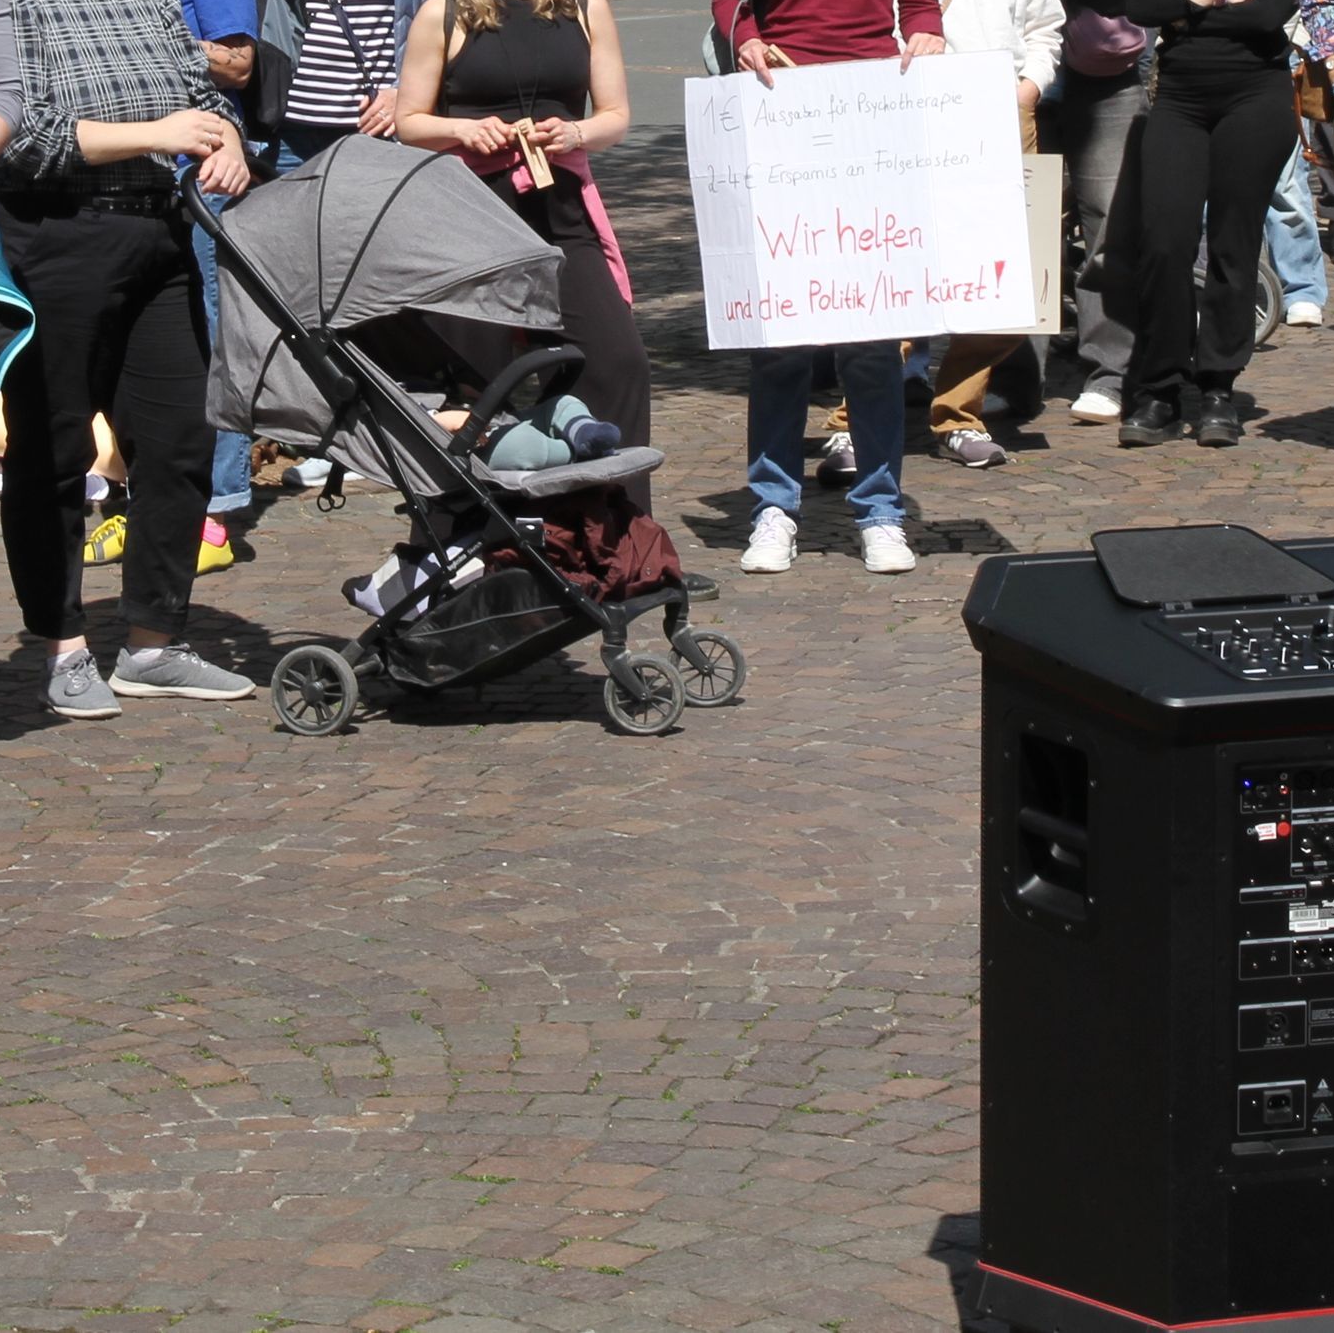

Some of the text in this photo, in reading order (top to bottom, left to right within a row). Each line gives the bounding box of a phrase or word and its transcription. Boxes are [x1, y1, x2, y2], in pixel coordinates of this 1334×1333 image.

[846, 163, 865, 178] an
[757, 207, 924, 263] Wir helfen
[725, 289, 753, 322] und
[758, 280, 799, 322] die
